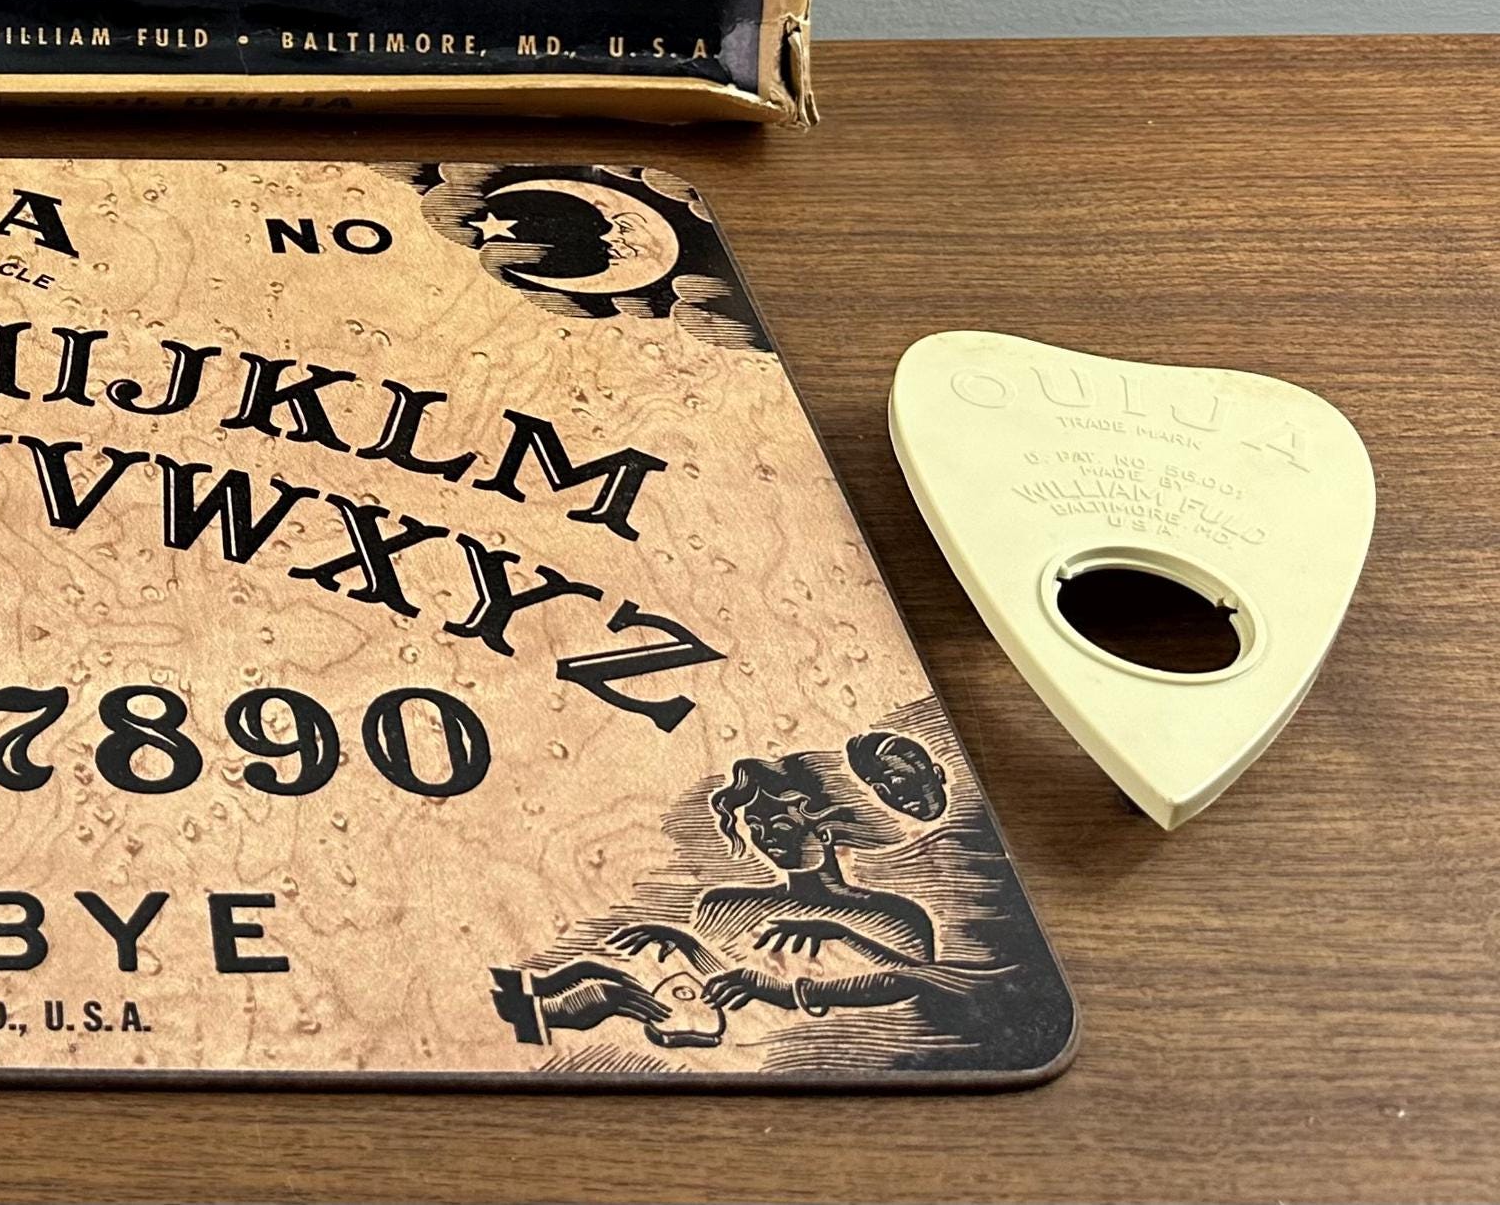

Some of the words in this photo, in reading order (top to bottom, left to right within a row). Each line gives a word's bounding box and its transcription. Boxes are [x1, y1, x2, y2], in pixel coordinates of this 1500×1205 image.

[136, 27, 210, 49] FULD
[280, 30, 488, 58] BALTIMORE,
[264, 217, 395, 256] NO
[949, 365, 1311, 474] OUIJA
[1056, 414, 1128, 434] TRADE
[1135, 424, 1202, 452] MARK
[1079, 464, 1144, 484] MADE
[1158, 475, 1183, 493] BY
[1010, 478, 1165, 508] WILLIAM
[1179, 494, 1268, 546] FULD
